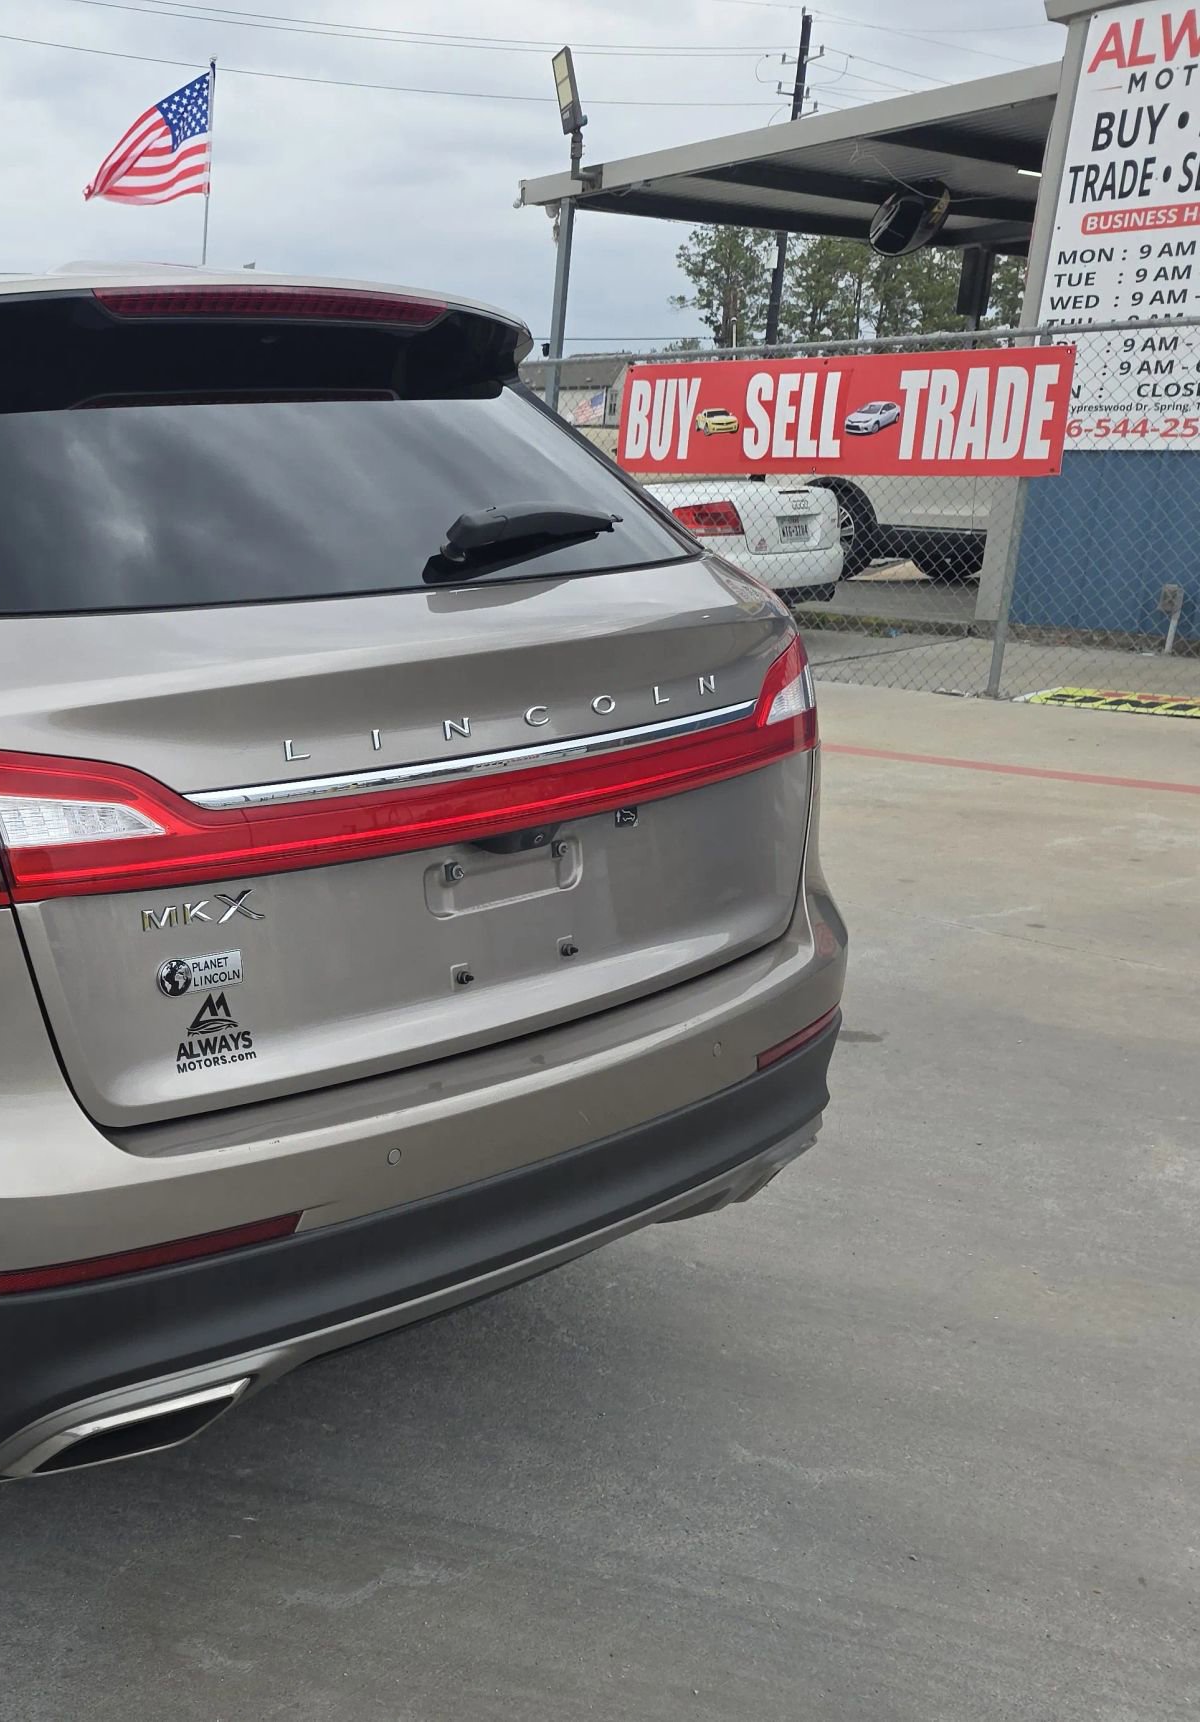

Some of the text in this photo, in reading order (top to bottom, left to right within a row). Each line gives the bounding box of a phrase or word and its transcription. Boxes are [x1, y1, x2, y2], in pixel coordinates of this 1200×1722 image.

[1127, 63, 1199, 94] MOT
[1091, 103, 1170, 152] BUY
[1068, 151, 1200, 204] TRADE S
[1085, 205, 1200, 231] BUSINESS H
[1057, 247, 1115, 265] MON
[1139, 244, 1152, 260] 9
[1157, 240, 1197, 258] AM
[1053, 271, 1097, 288] TUE
[1135, 268, 1148, 283] 9
[1152, 264, 1192, 282] AM
[1050, 294, 1100, 311] WED
[1131, 291, 1144, 307] 9
[1148, 288, 1188, 305] AM
[1123, 338, 1136, 353] 9
[1141, 336, 1179, 352] AM
[1119, 361, 1132, 375] 9
[1136, 360, 1175, 375] AM
[1136, 382, 1200, 399] CLOS
[624, 363, 1060, 461] BUY SELL TRADE
[1071, 402, 1133, 414] ypresswood
[284, 674, 716, 761] LINCOLN
[141, 889, 265, 932] MKX
[191, 956, 229, 972] PLANET
[193, 969, 241, 987] LINCOLN
[176, 1031, 253, 1062] ALWAYS
[176, 1050, 257, 1074] MOTORS.com
